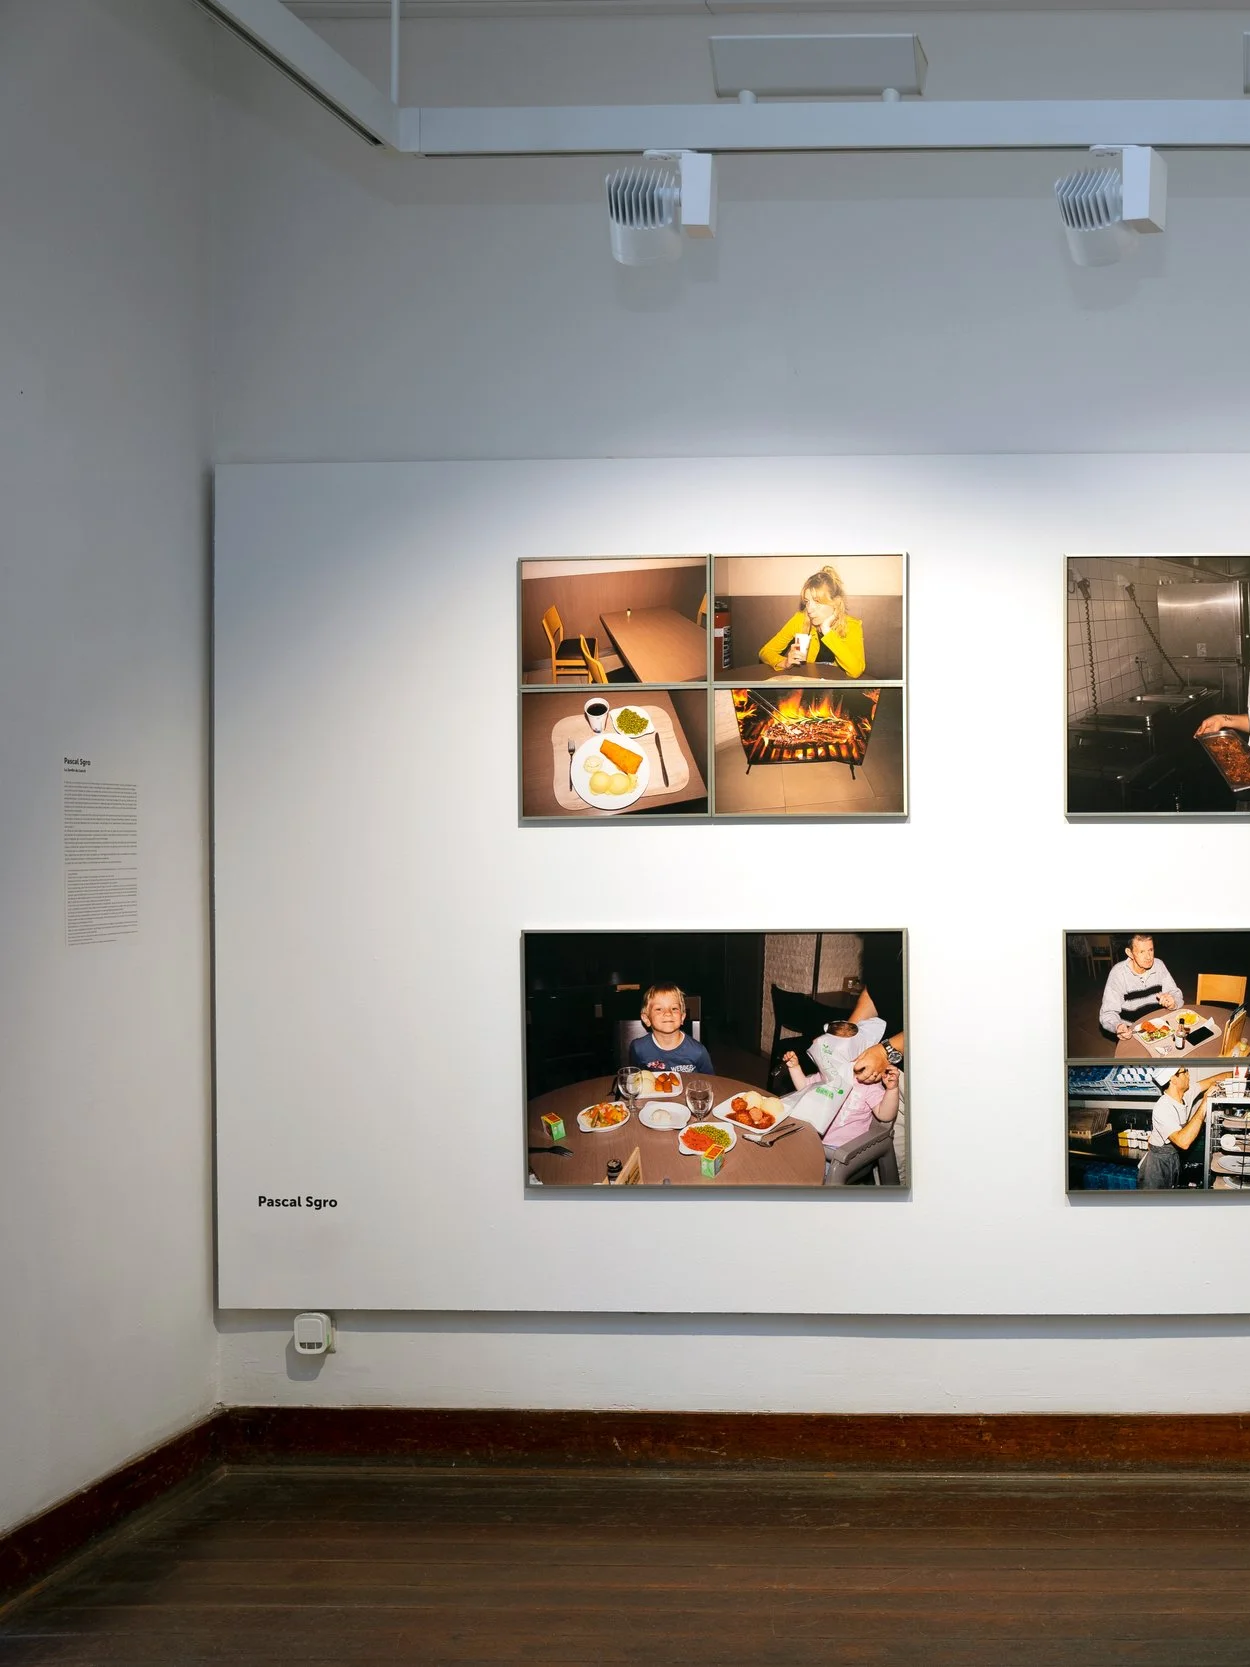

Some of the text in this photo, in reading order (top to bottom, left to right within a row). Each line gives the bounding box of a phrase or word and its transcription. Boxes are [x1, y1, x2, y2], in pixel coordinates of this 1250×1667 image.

[64, 757, 91, 767] Pascal Sgro
[258, 1195, 338, 1210] Pascal Sgro
